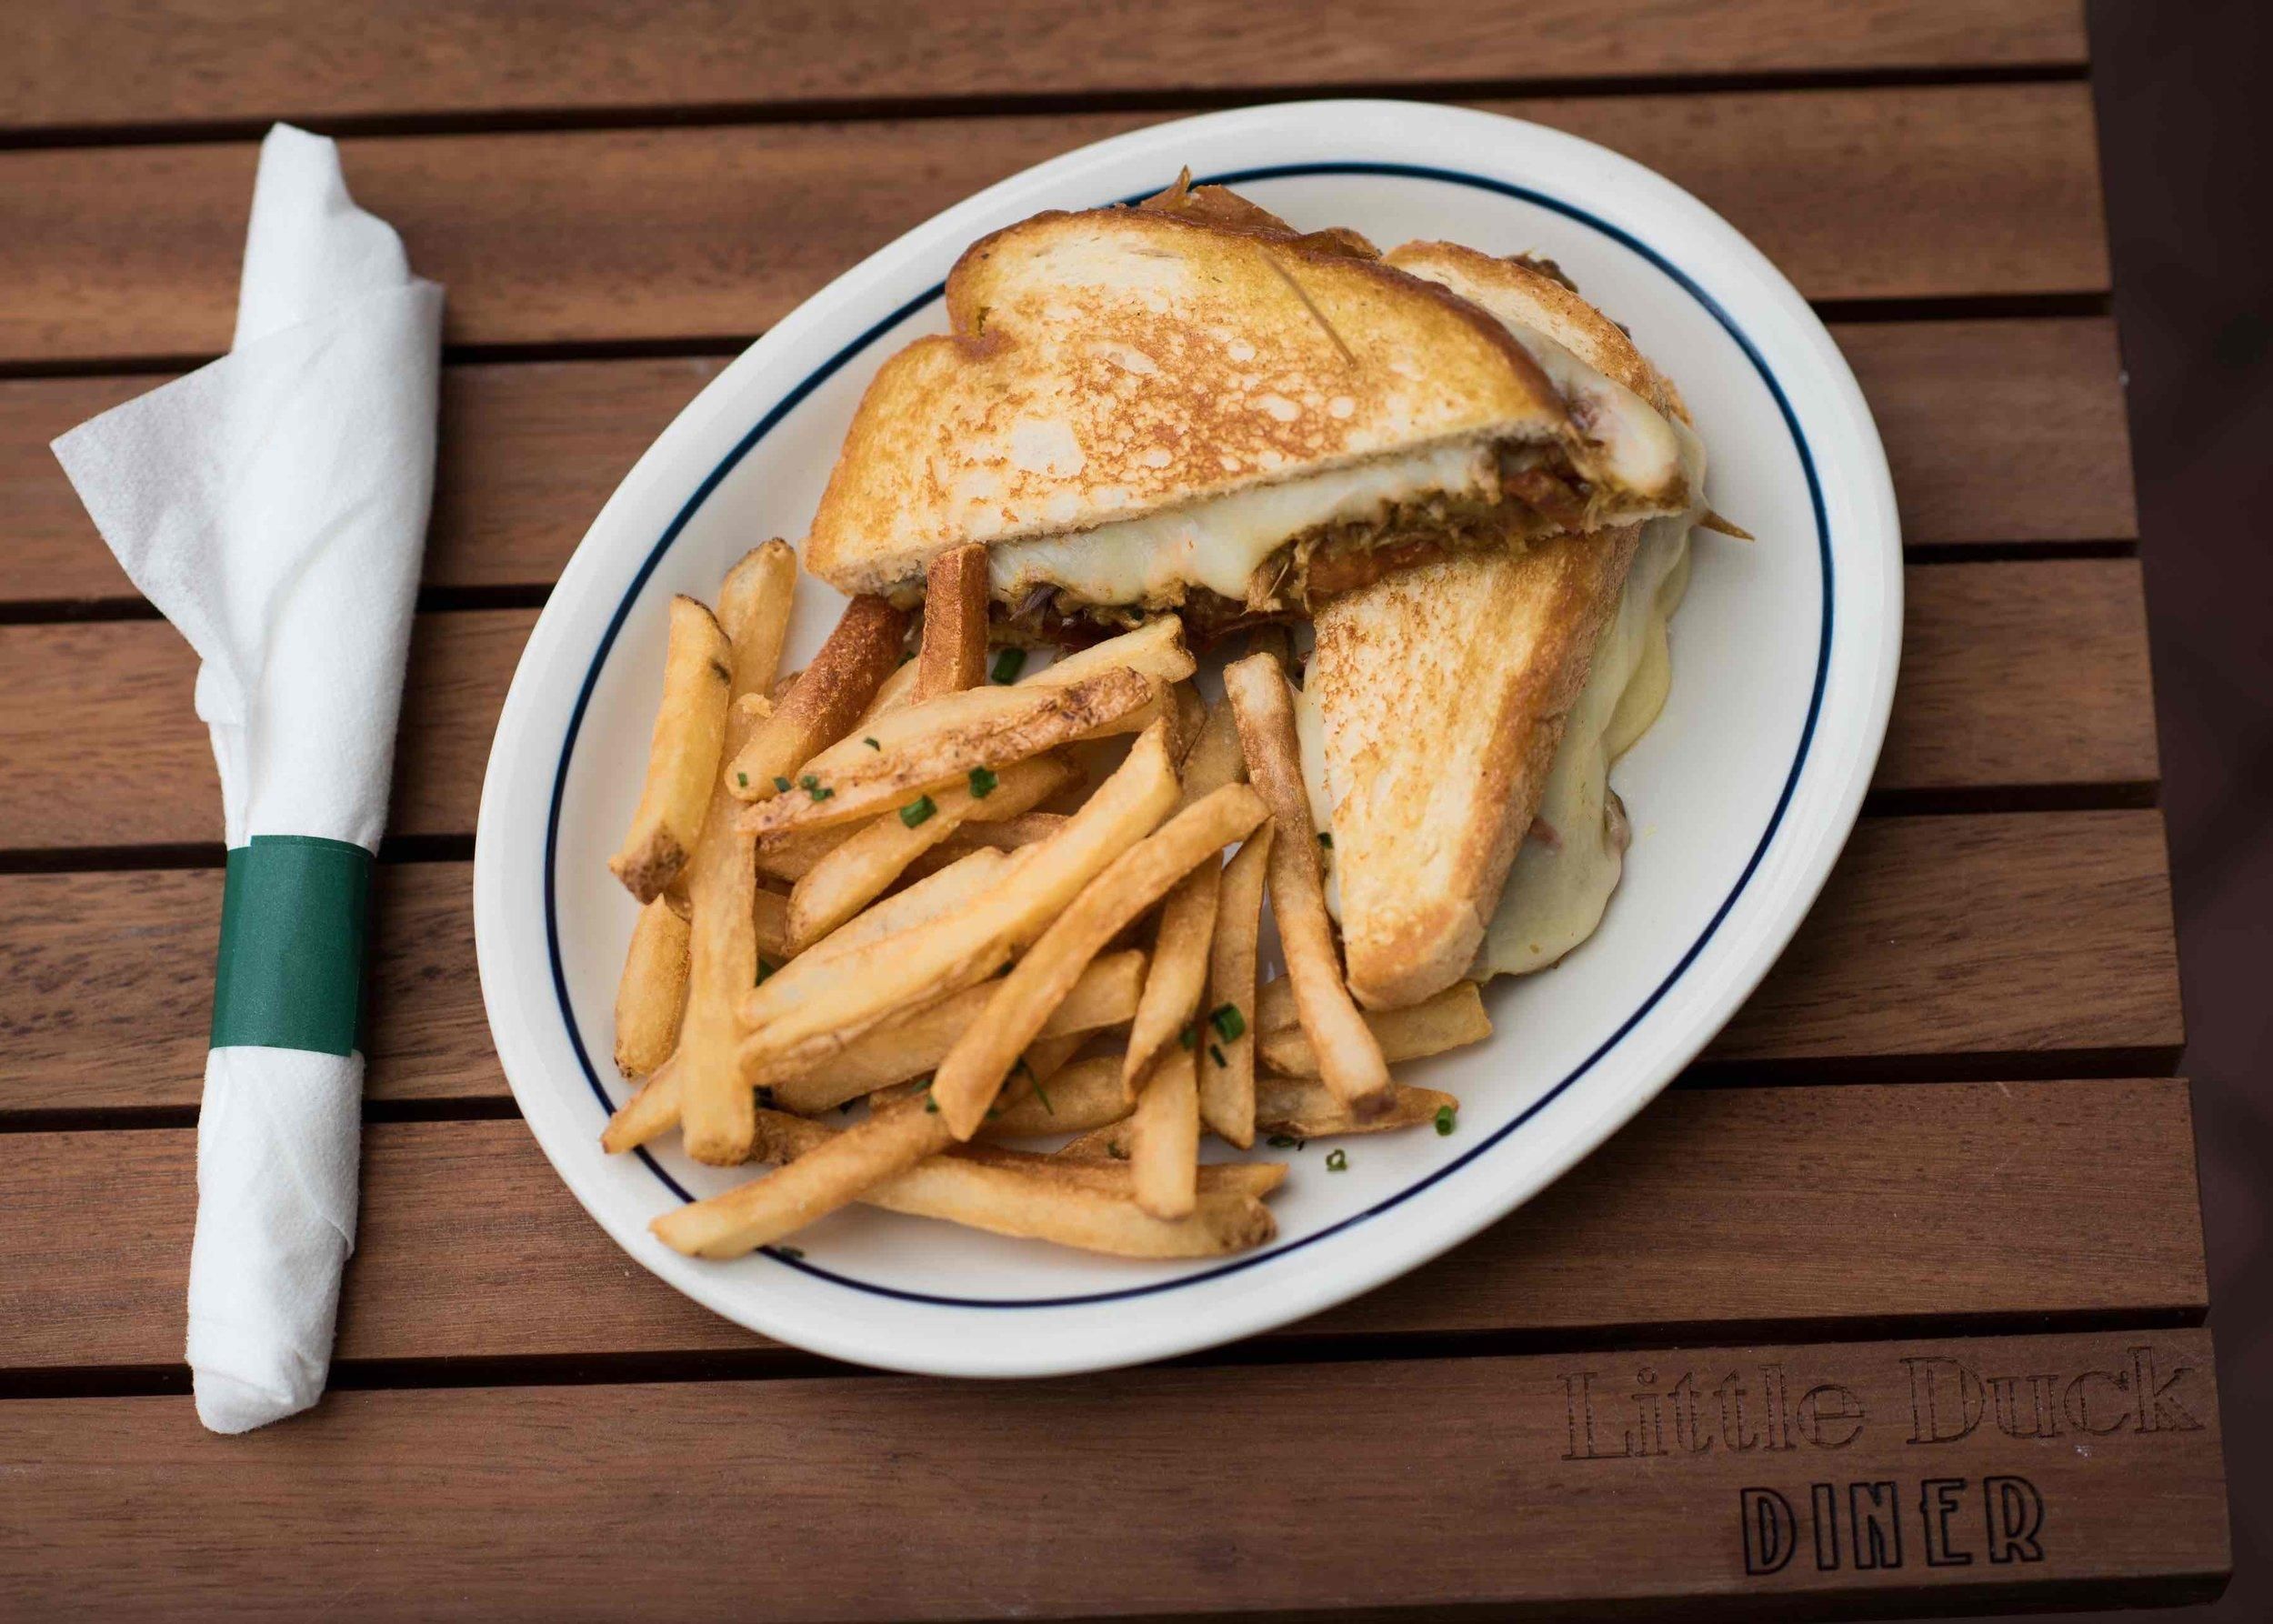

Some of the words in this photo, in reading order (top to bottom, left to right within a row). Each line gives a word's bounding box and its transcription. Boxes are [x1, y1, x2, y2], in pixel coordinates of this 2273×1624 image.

[1557, 1362, 1866, 1460] Little
[1899, 1346, 2207, 1445] Duck
[1740, 1475, 2045, 1576] DINER
